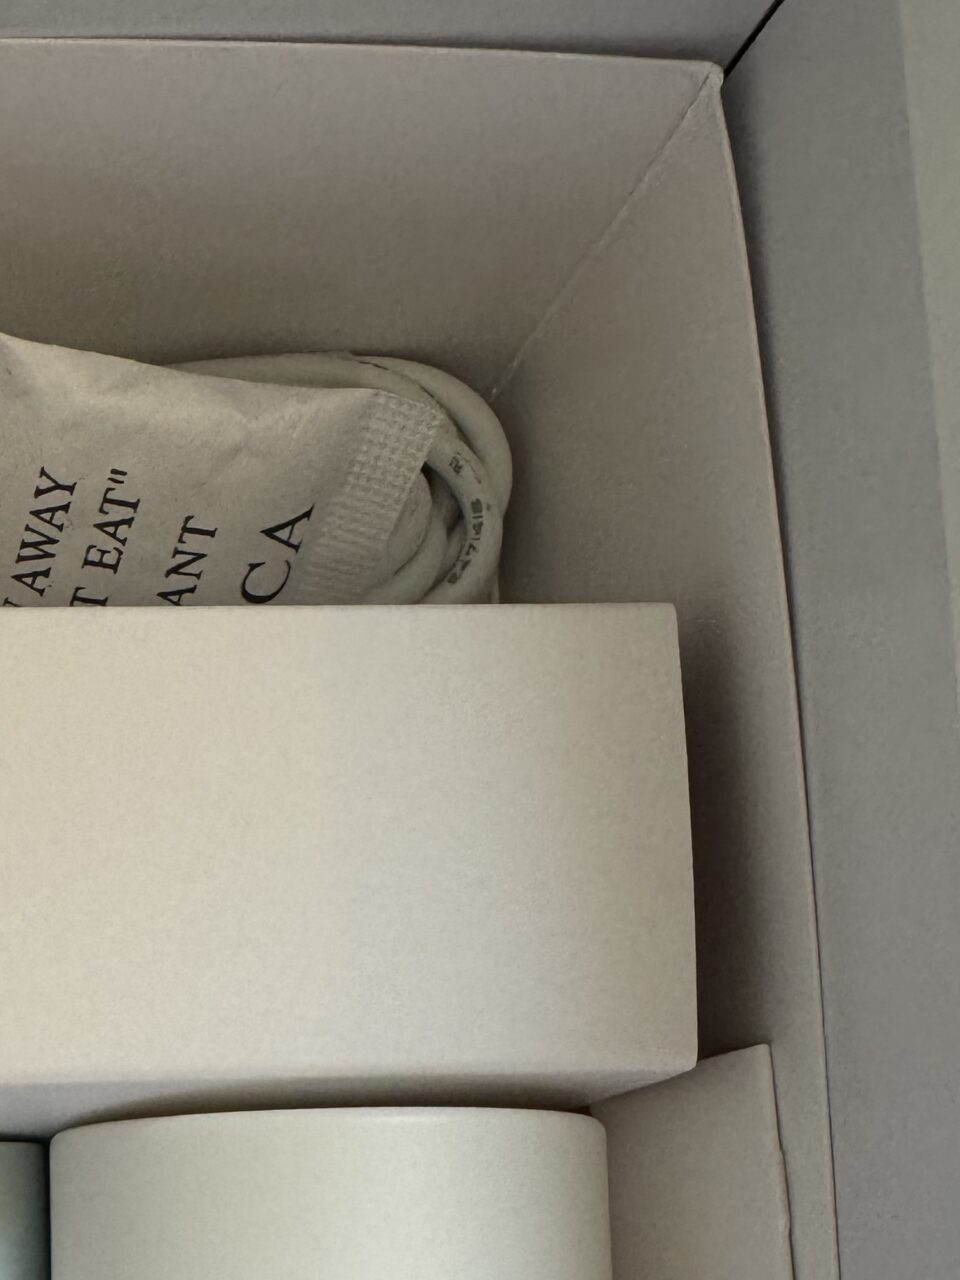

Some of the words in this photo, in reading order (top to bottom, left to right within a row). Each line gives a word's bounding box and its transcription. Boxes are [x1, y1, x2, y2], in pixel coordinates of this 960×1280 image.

[11, 466, 79, 596] AWAY
[81, 469, 140, 574] EAT"
[240, 504, 315, 604] CA
